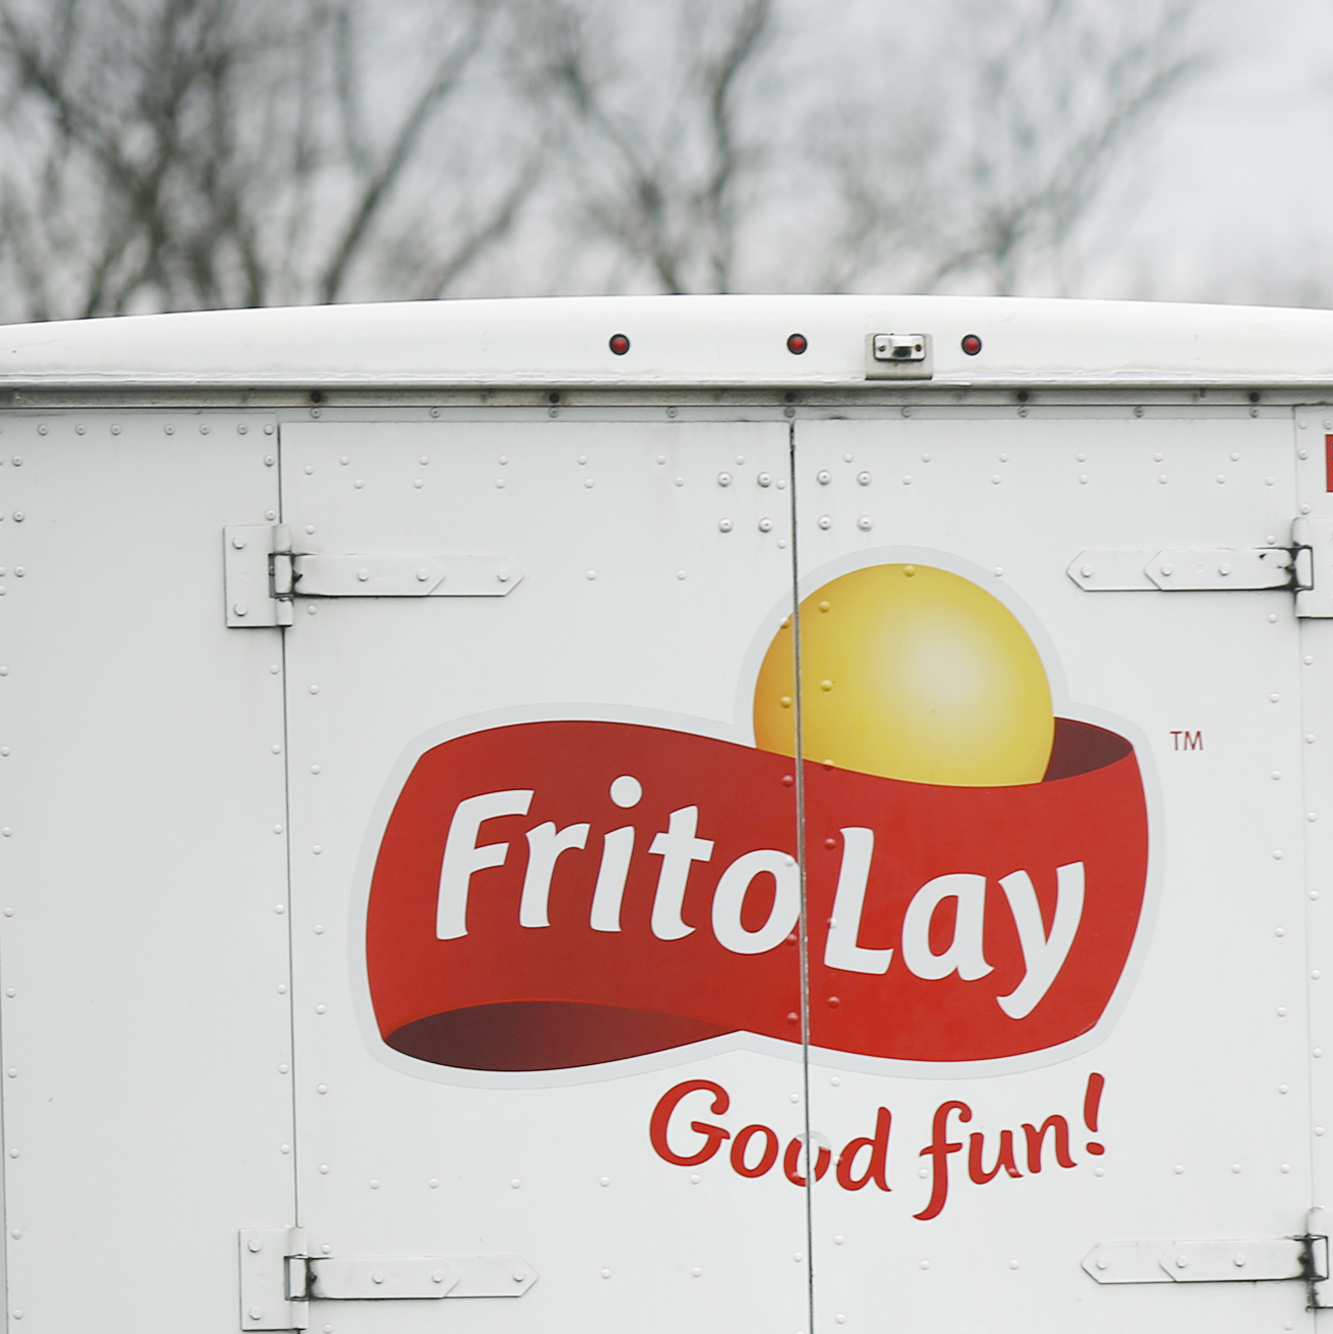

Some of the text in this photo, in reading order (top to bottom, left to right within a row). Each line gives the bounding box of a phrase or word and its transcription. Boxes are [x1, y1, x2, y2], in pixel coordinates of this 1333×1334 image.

[1169, 730, 1203, 751] TM
[649, 1072, 1106, 1222] Good fun!
